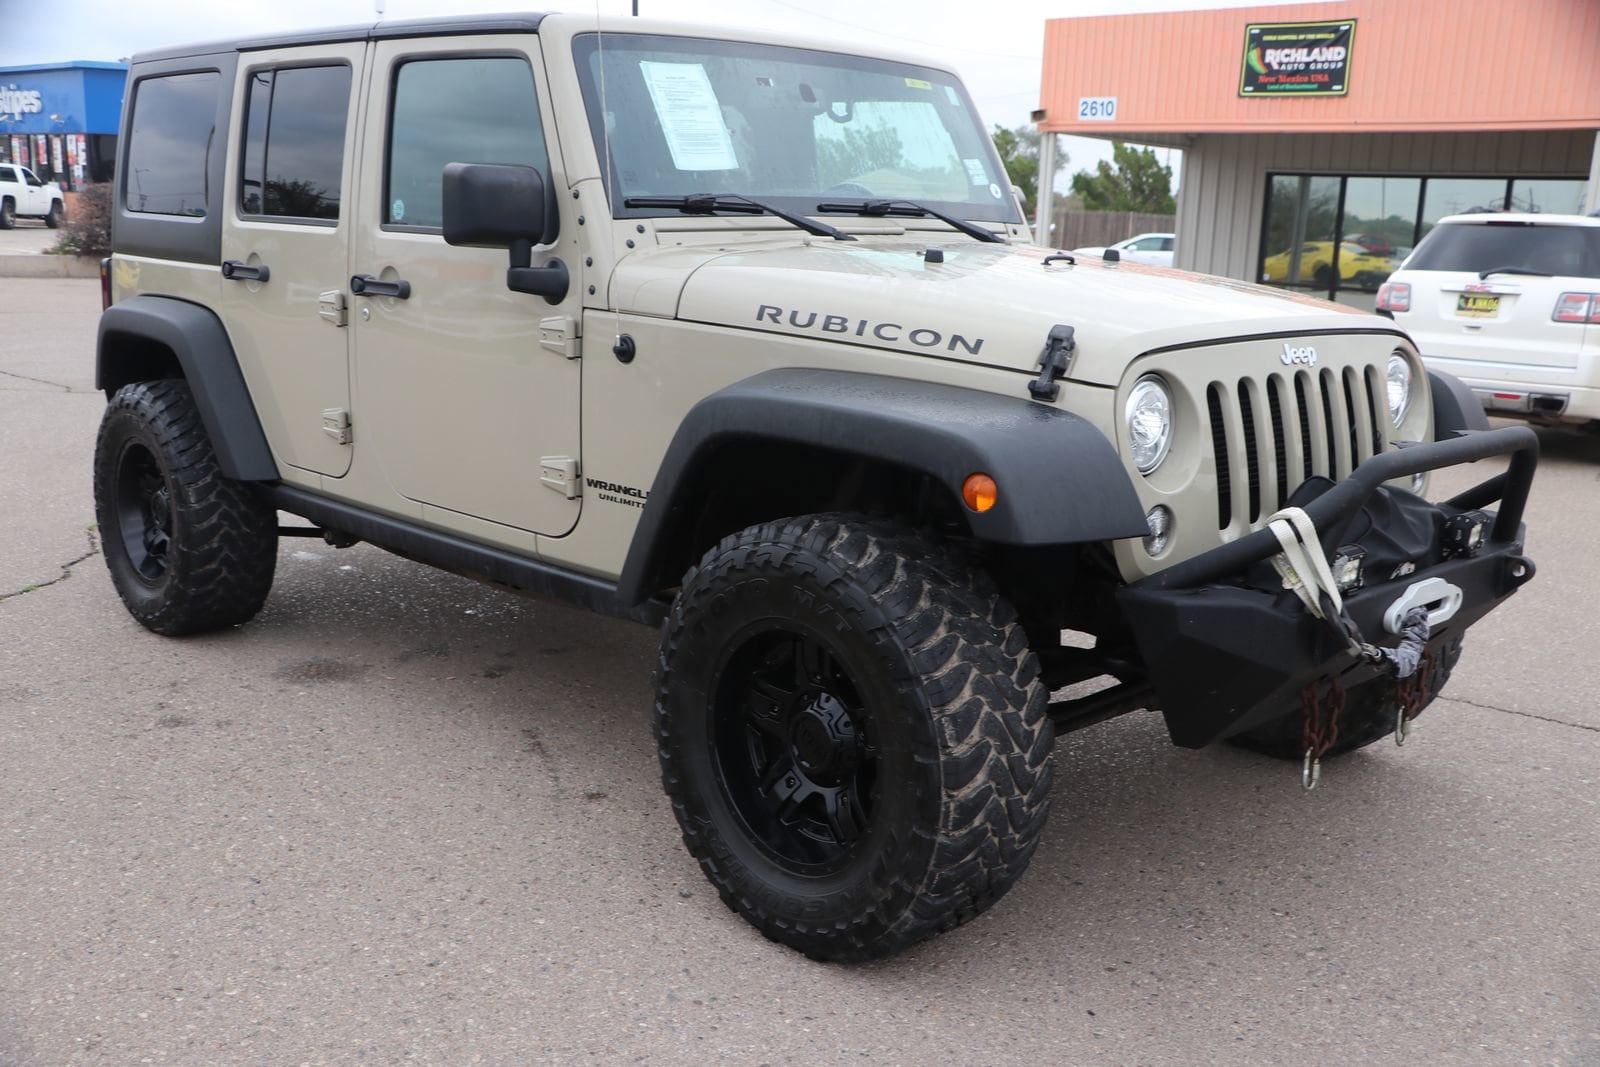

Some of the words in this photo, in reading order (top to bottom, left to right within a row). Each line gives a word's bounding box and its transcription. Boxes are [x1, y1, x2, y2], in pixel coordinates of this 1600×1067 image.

[1264, 46, 1347, 70] RICHLAND
[1281, 63, 1306, 71] AUTO
[1309, 62, 1344, 70] GROUP
[1279, 74, 1309, 83] Mexico
[1311, 73, 1329, 82] USA
[0, 83, 42, 121] tripes
[1080, 100, 1115, 117] 2610
[755, 304, 985, 356] RUBICON
[1281, 343, 1317, 367] Jeep
